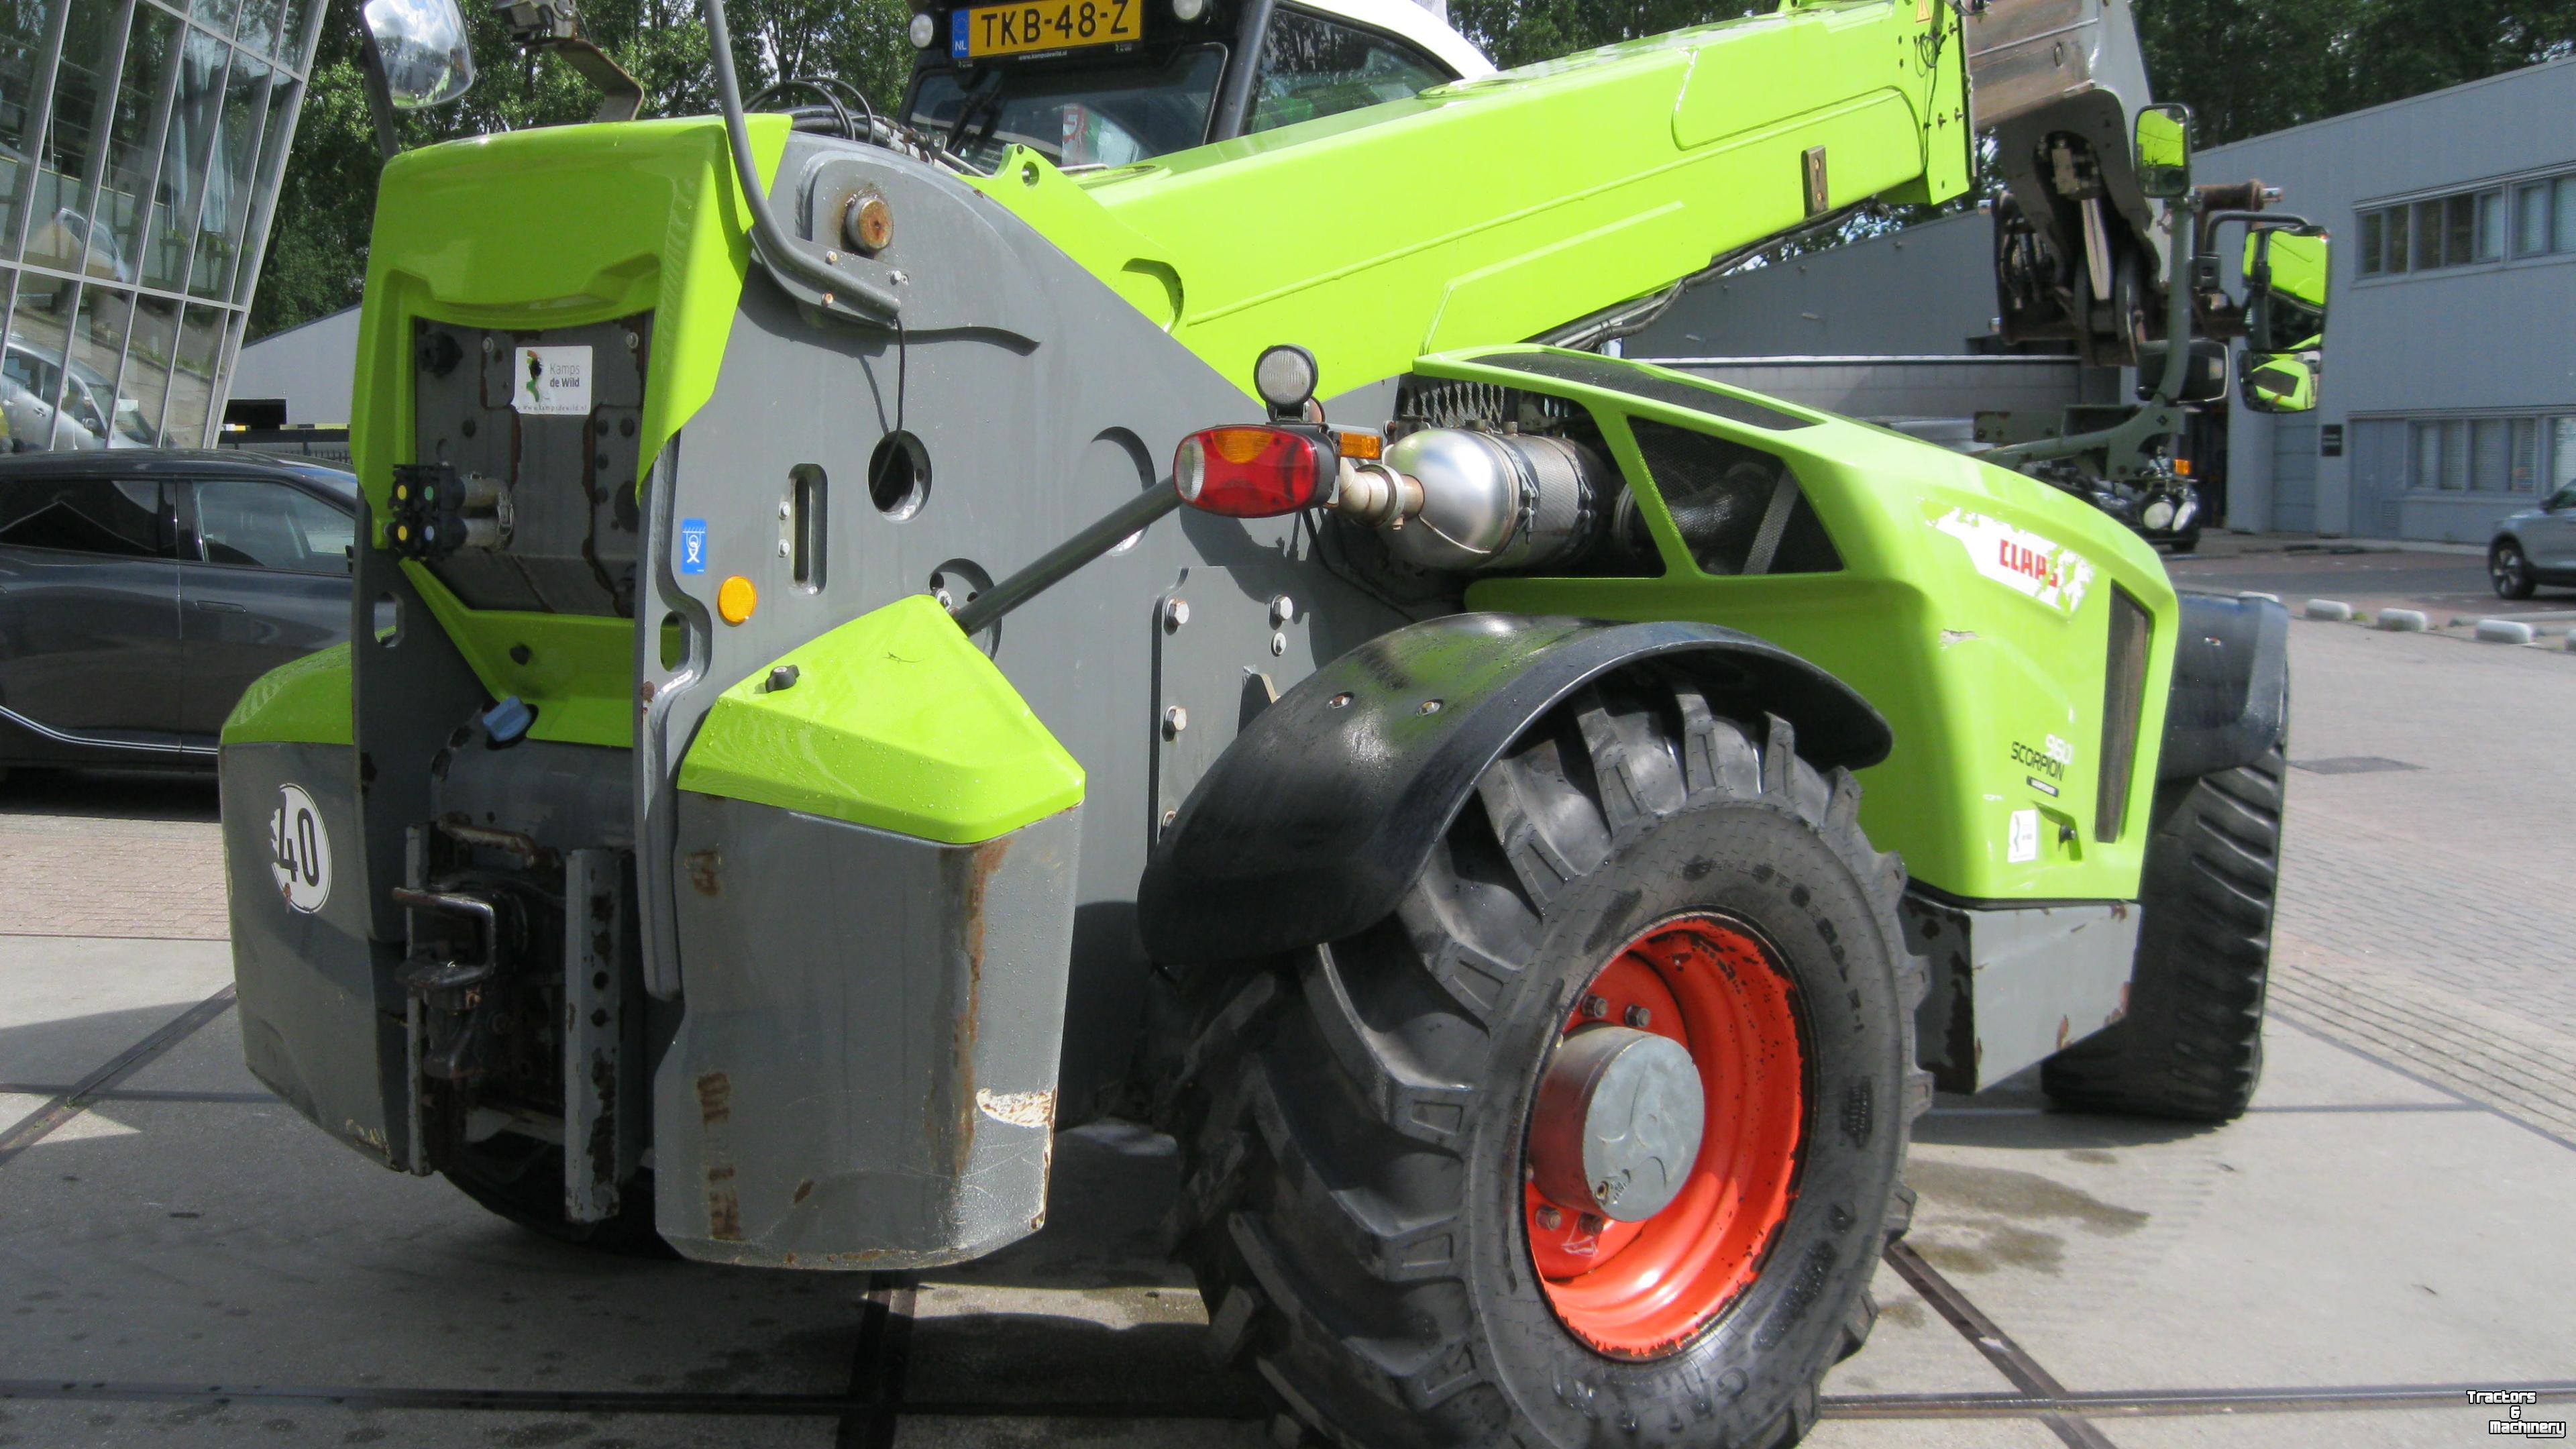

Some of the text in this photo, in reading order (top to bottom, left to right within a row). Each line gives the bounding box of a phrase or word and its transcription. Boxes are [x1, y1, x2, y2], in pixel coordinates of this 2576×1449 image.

[981, 0, 1129, 48] TKB-48-Z
[955, 40, 967, 51] NL
[549, 363, 580, 376] Kamps
[549, 377, 580, 388] de Wild
[2010, 741, 2065, 781] SCORPION
[278, 802, 320, 888] 40
